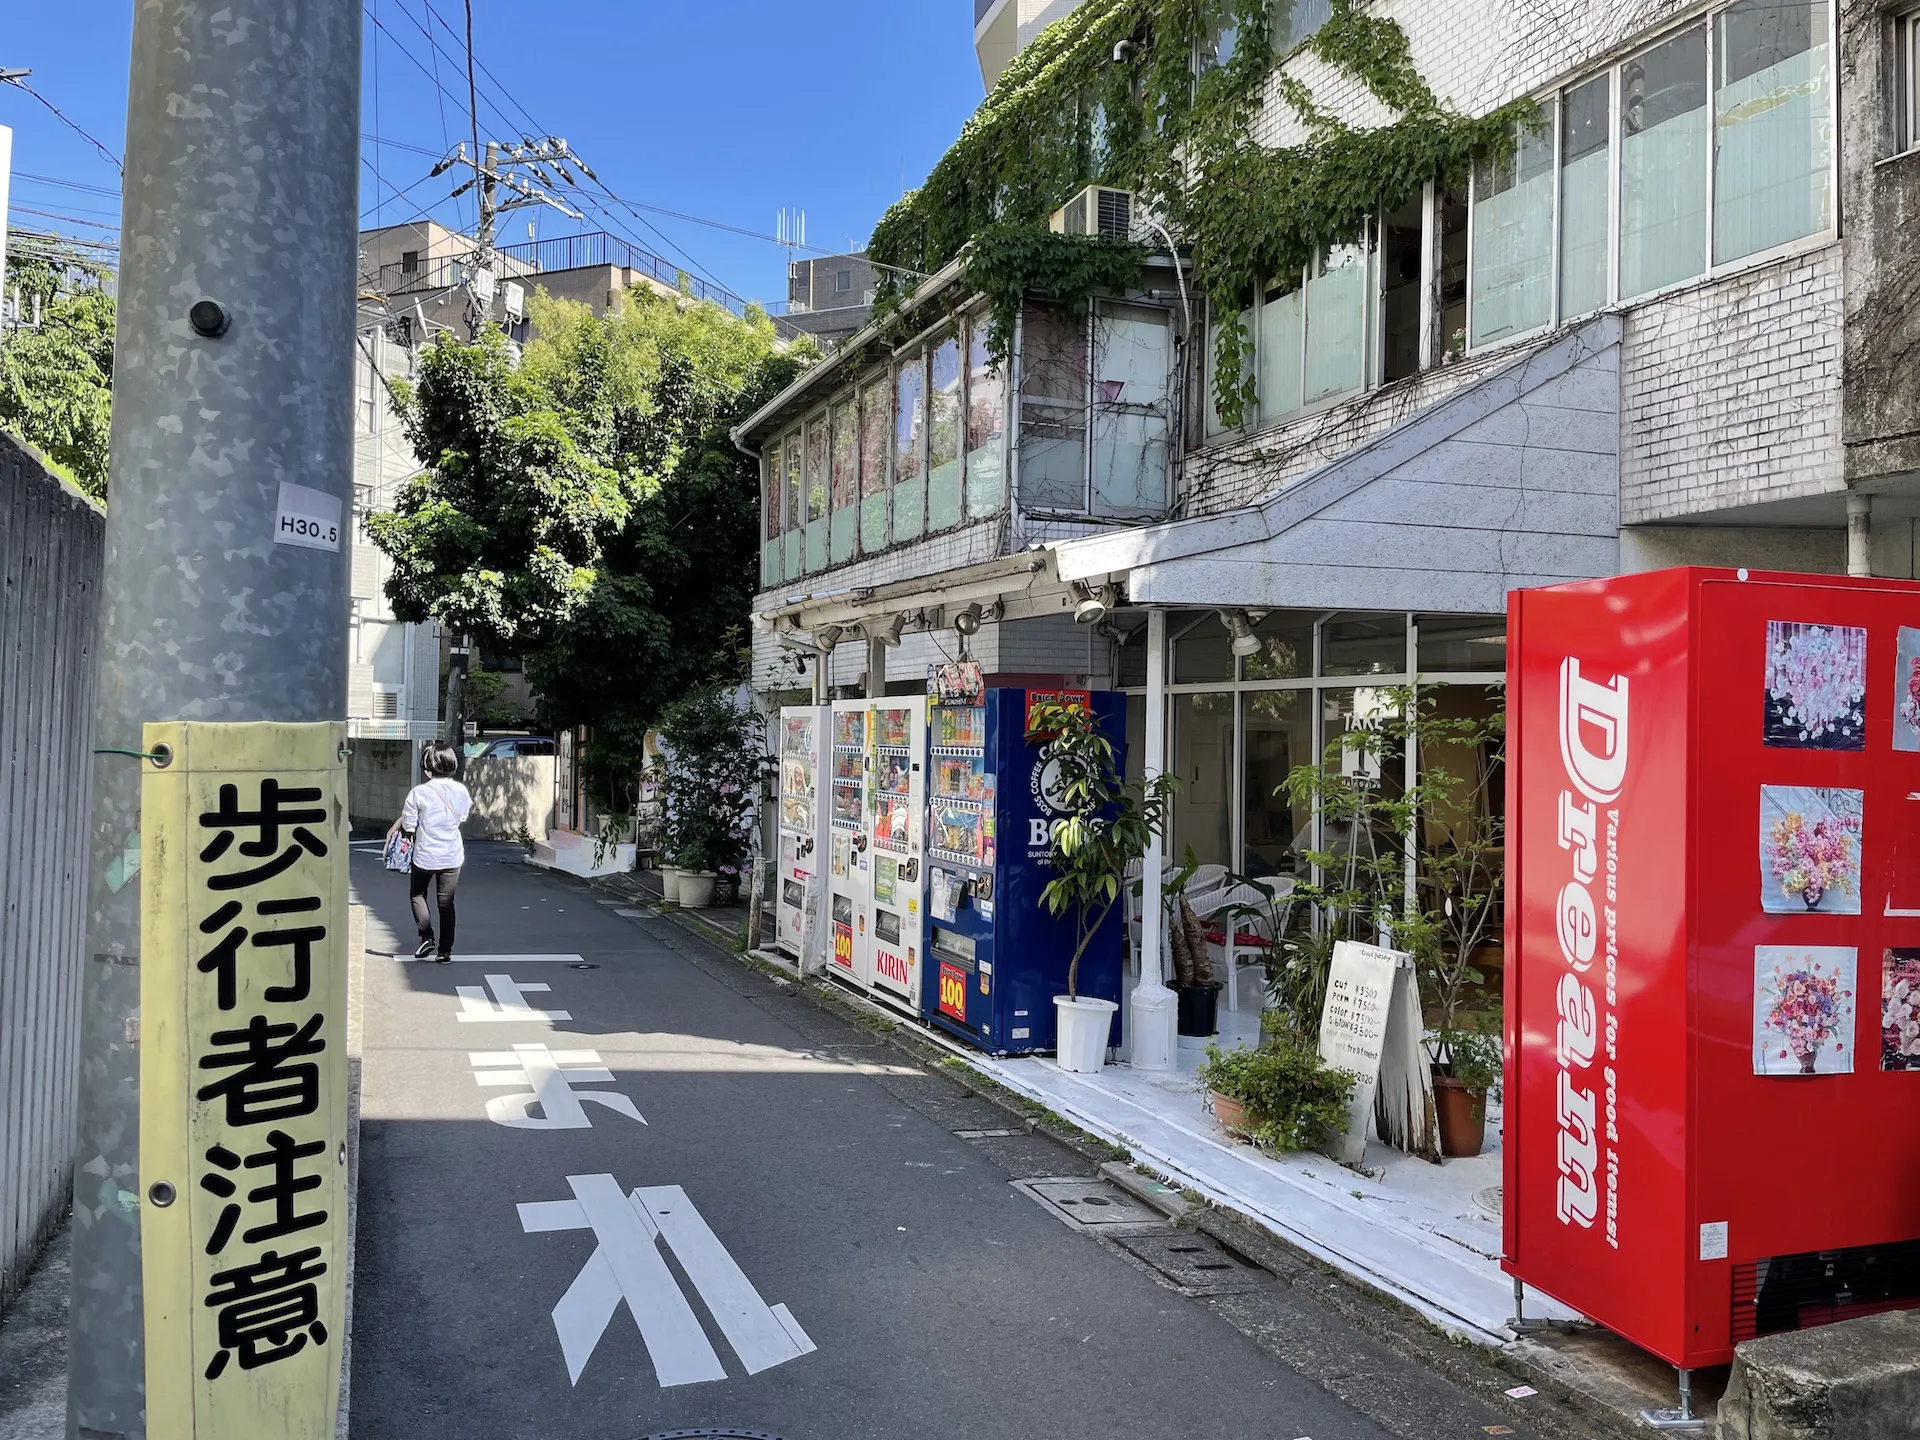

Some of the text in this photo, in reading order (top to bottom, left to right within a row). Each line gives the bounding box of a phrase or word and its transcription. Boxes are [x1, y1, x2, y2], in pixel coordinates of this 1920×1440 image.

[281, 516, 337, 543] H30.5
[1605, 808, 1620, 904] Various
[836, 934, 851, 959] 100
[877, 949, 908, 985] KIRIN
[1555, 655, 1629, 1229] Dream
[1604, 905, 1619, 1007] prices
[941, 975, 964, 1011] 100
[1347, 1044, 1378, 1060] treatment
[1605, 1011, 1619, 1062] for
[196, 777, 328, 1381] 歩行者注意
[1603, 1065, 1619, 1144] good
